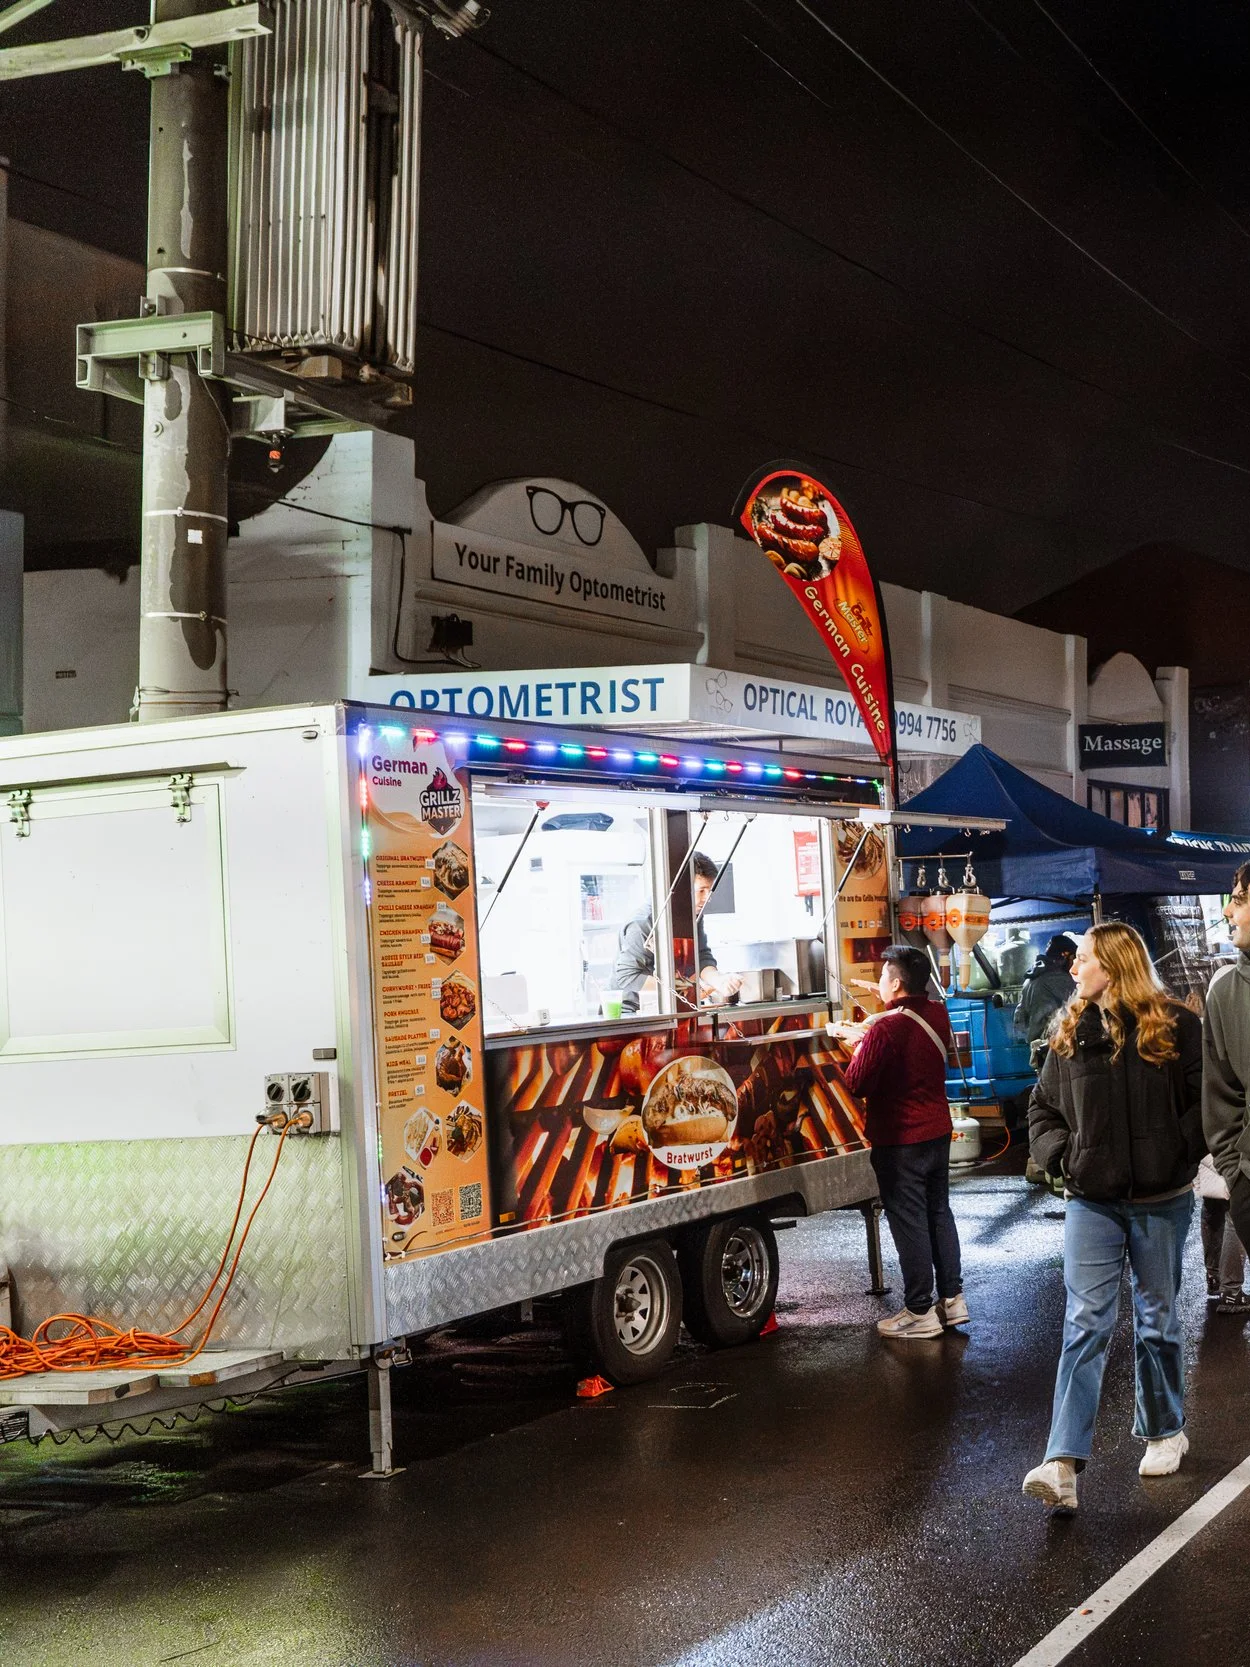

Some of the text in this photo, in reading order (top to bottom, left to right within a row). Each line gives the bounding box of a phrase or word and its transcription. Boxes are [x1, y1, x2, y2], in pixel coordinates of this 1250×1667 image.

[454, 542, 667, 612] Your Family Optometrist
[837, 601, 868, 643] Master
[804, 586, 886, 733] German Cuisine
[389, 677, 665, 718] OPTOMETRIST
[743, 683, 818, 722] OPTICAL
[825, 698, 866, 729] ROYA
[926, 715, 957, 743] 7756
[1083, 735, 1162, 755] Massage
[372, 755, 428, 775] German
[372, 775, 402, 787] Cuisine
[420, 789, 460, 806] GRILLZ
[421, 805, 461, 820] MASTER
[666, 1146, 713, 1164] Bratwurst
